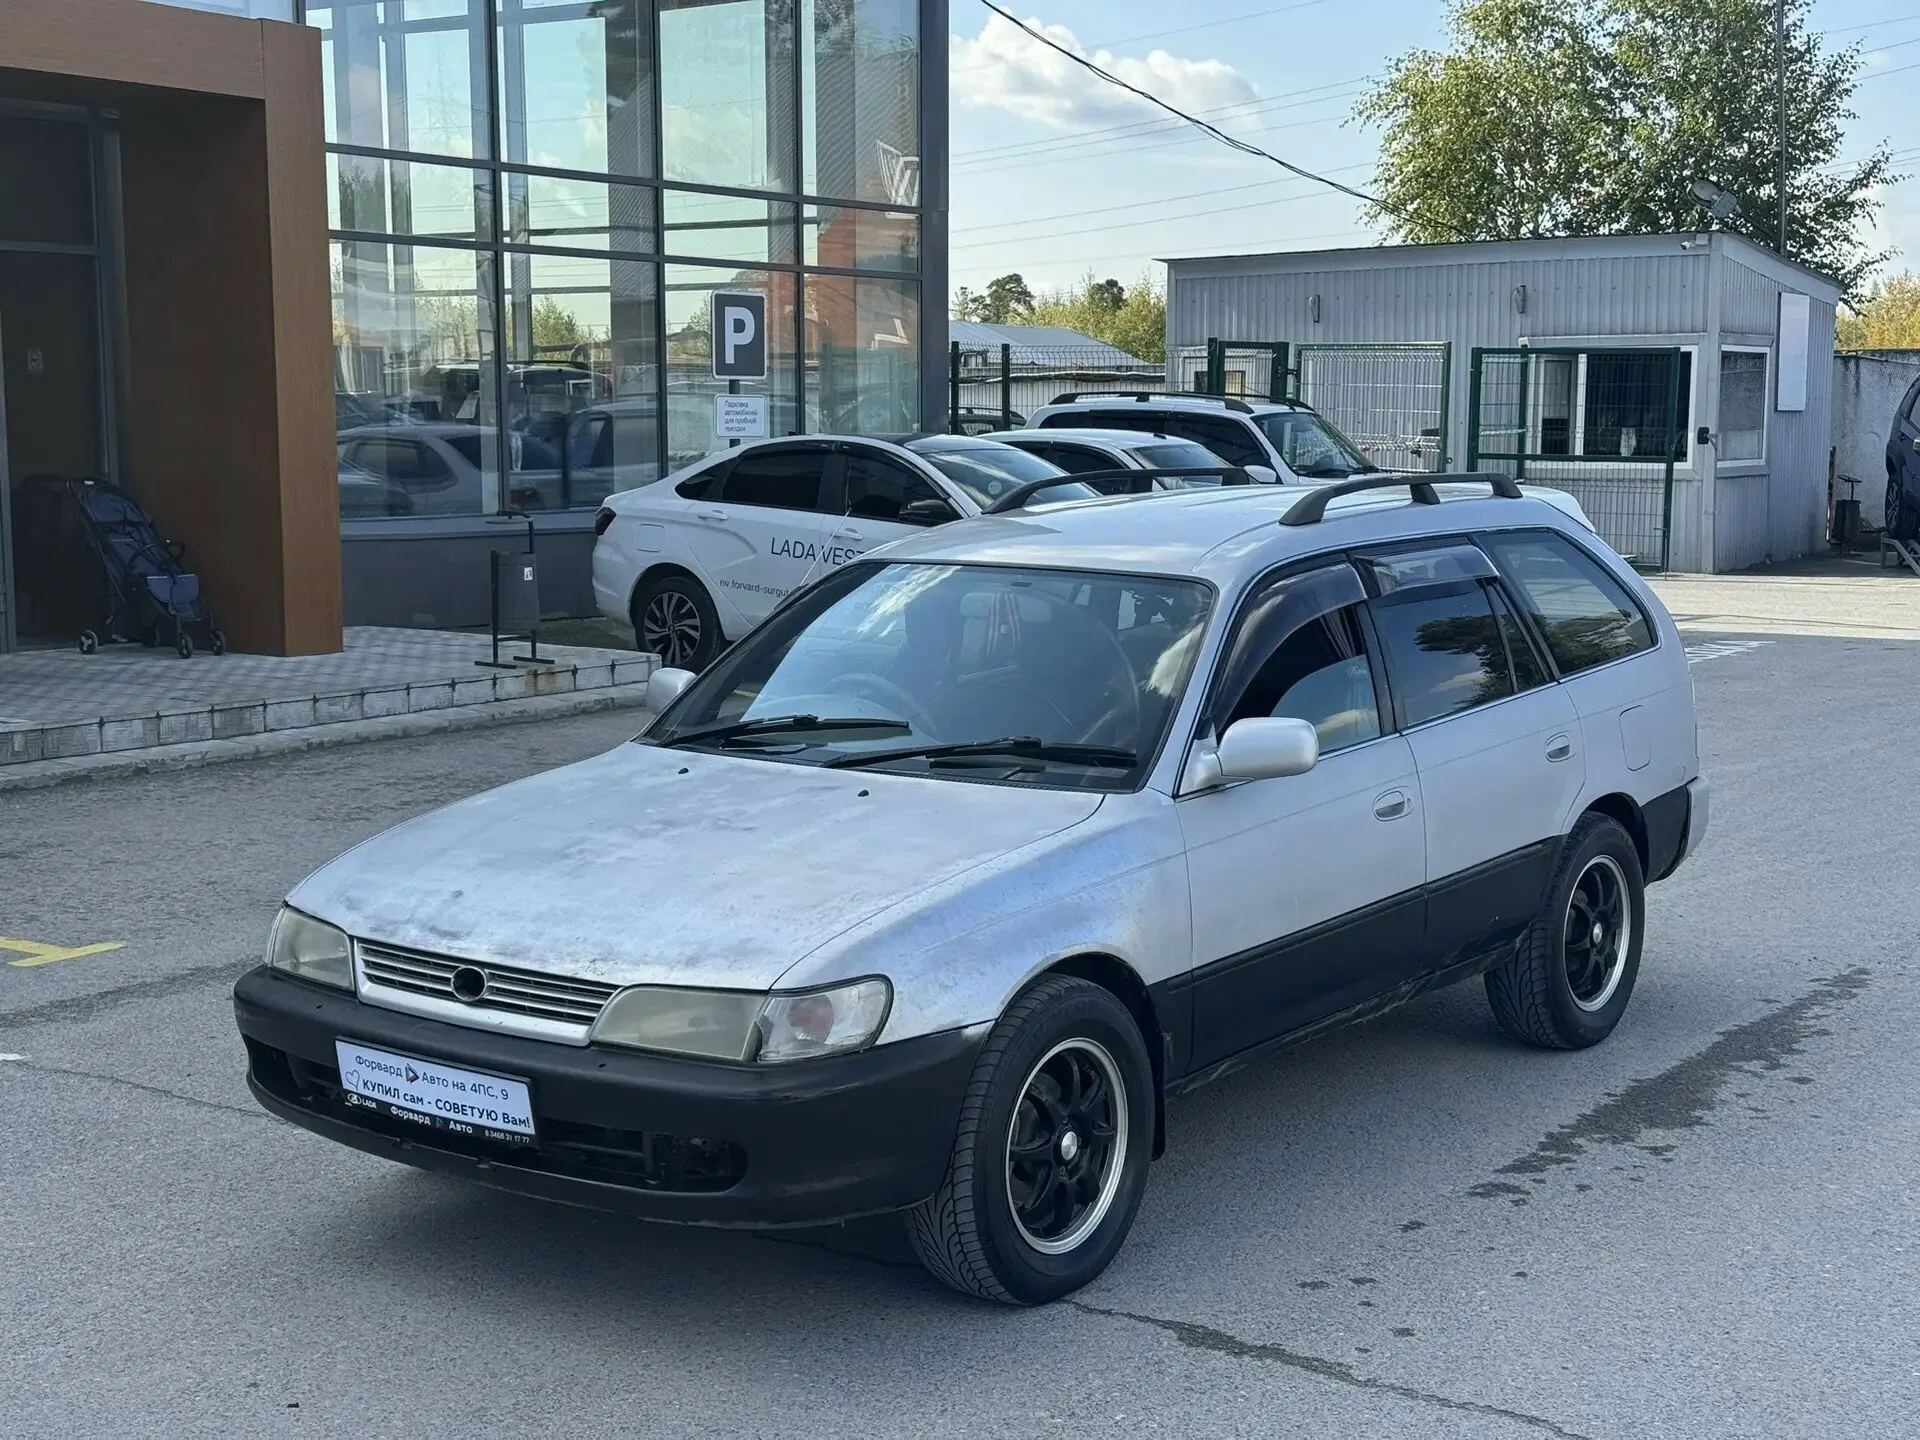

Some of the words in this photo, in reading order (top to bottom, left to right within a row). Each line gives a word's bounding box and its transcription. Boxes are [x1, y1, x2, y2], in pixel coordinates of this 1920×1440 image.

[724, 306, 755, 364] P
[724, 408, 758, 416] автомобилей
[724, 417, 735, 425] для
[735, 416, 757, 425] пробной
[771, 537, 816, 562] LADA
[355, 1055, 403, 1078] Форвард
[421, 1072, 449, 1088] Авто
[452, 1081, 467, 1092] на
[501, 1089, 509, 1100] 9
[362, 1079, 400, 1100] КУПИЛ
[403, 1092, 424, 1106] сам
[435, 1098, 499, 1122] СОВЕТУЮ
[502, 1112, 530, 1128] Вам!
[390, 1105, 431, 1126] Форвард
[449, 1120, 473, 1134] Авто
